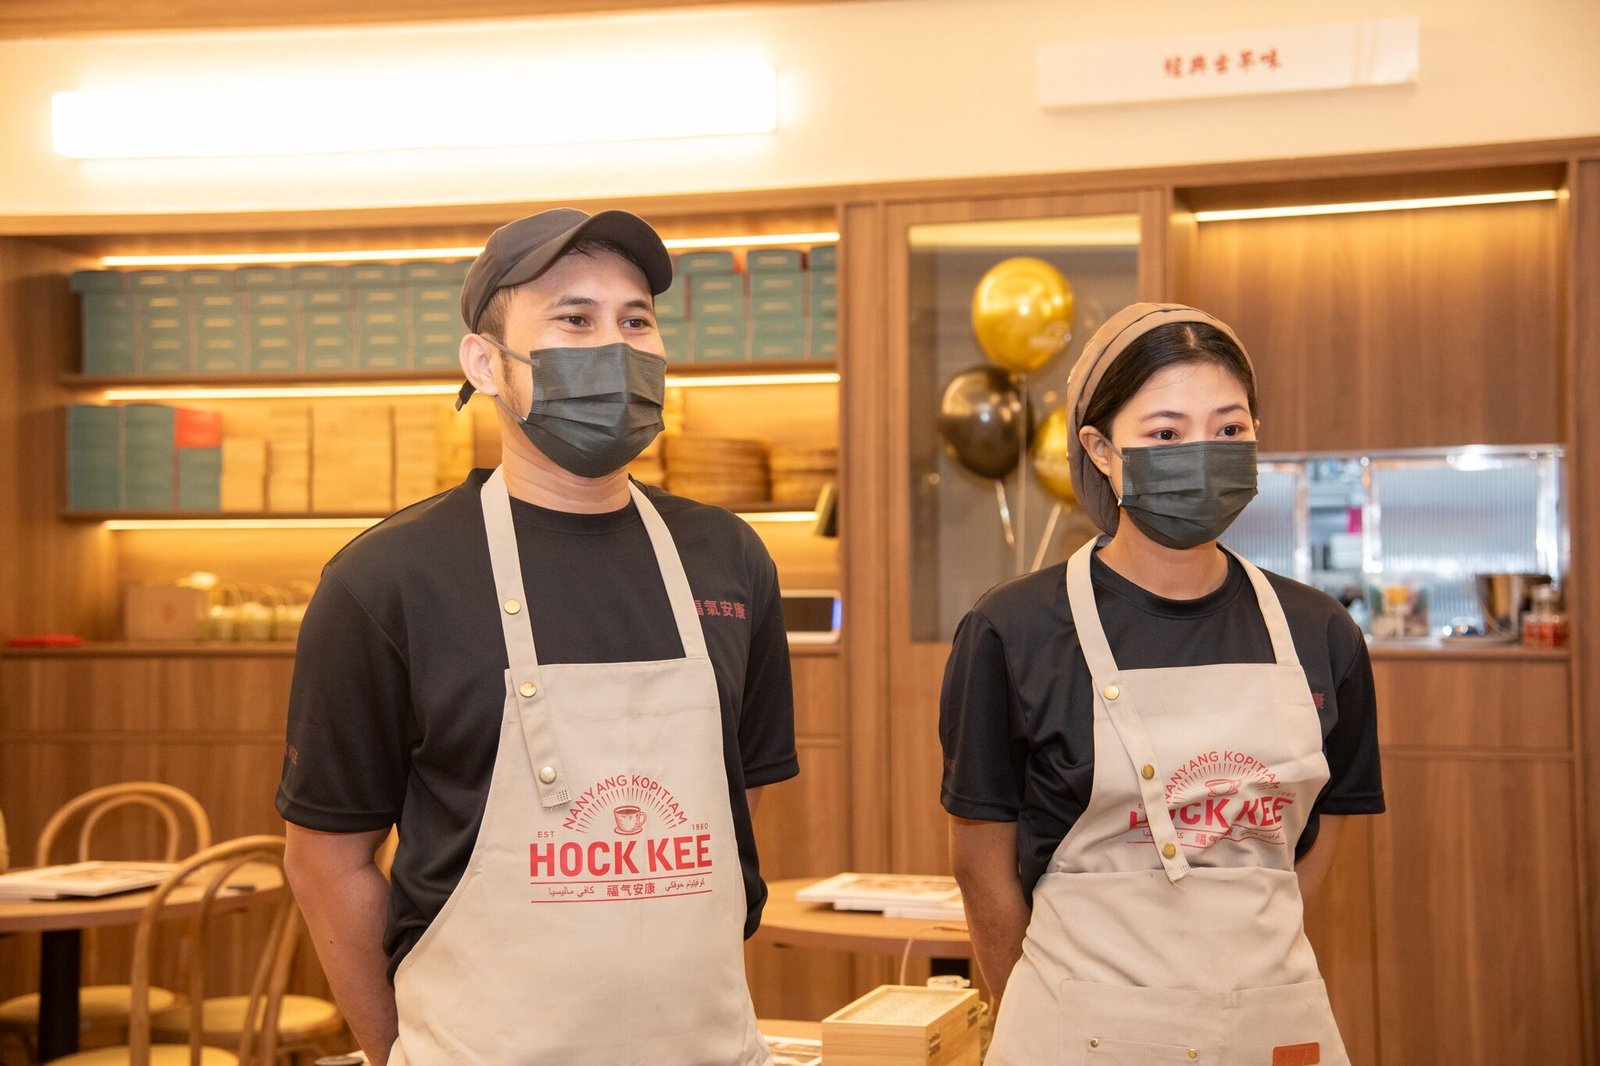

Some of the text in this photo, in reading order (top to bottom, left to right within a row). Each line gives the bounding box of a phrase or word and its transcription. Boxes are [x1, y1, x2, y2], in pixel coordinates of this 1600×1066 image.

[1223, 750, 1281, 790] KOPITIAM
[563, 774, 688, 830] NANYANG KOPITIAM
[1130, 796, 1294, 830] HCK KEE
[692, 822, 709, 831] 1980
[530, 834, 713, 877] HOCK KEE
[606, 882, 656, 897] 福气安康
